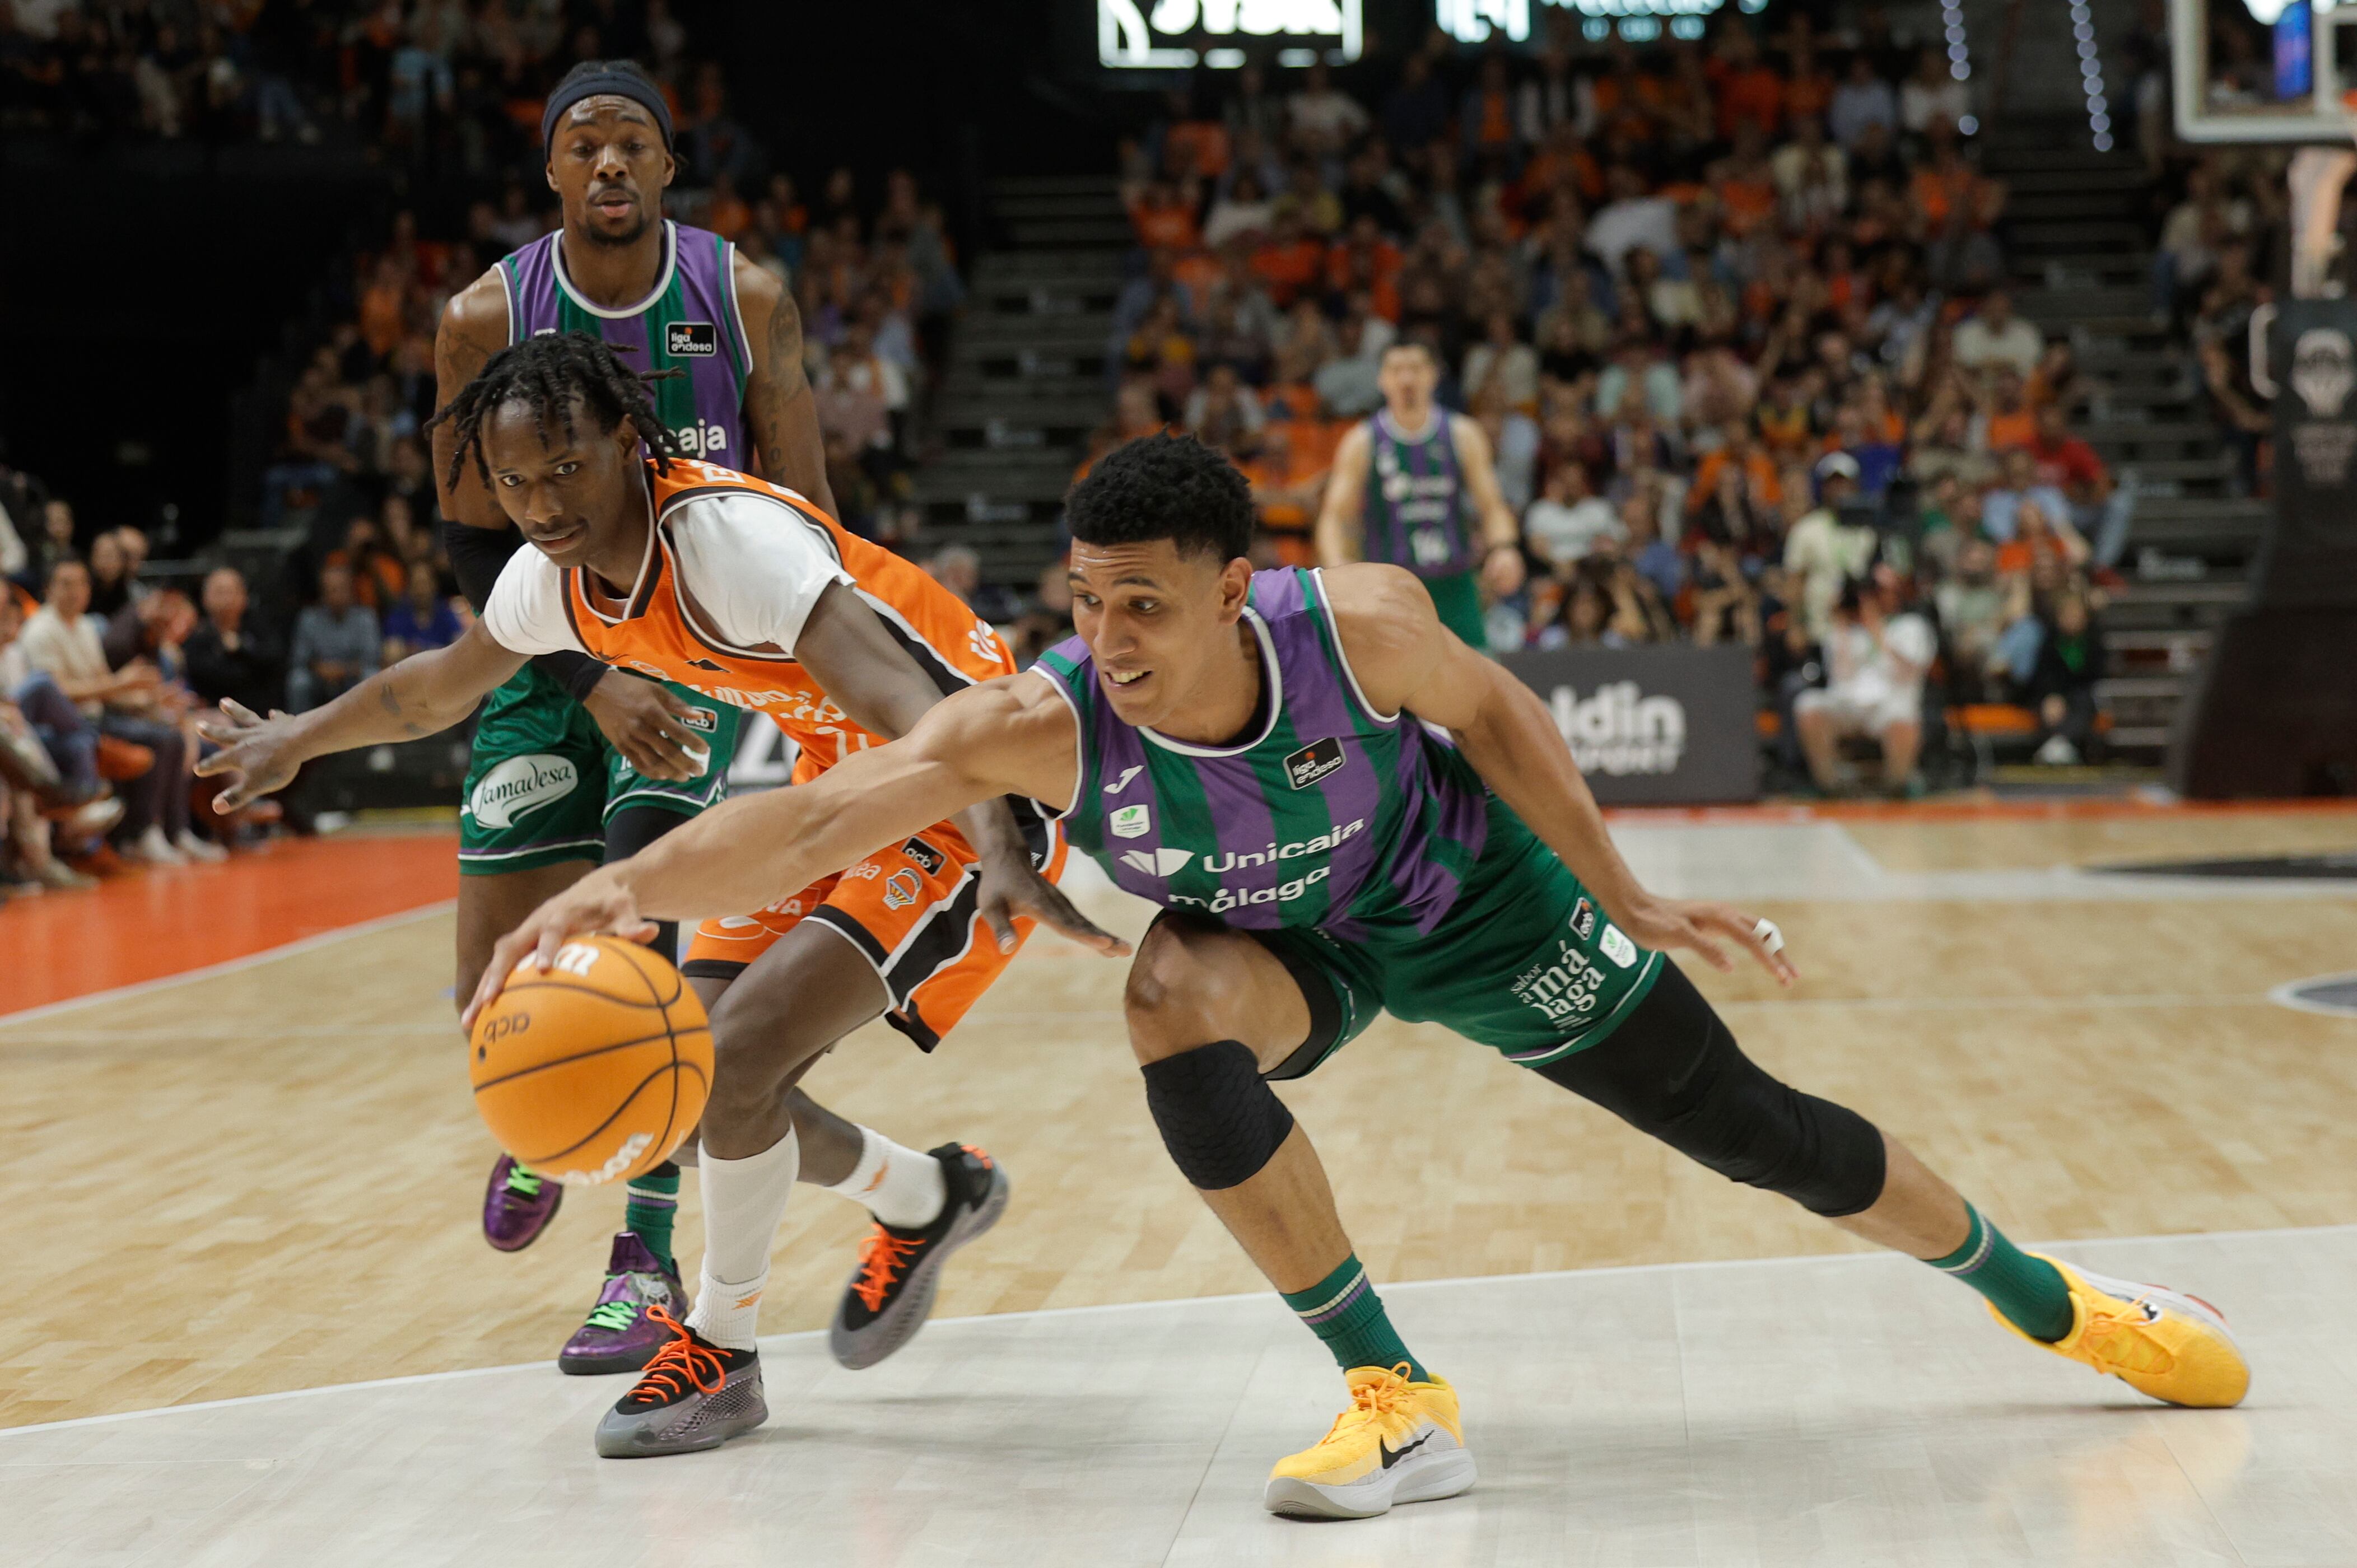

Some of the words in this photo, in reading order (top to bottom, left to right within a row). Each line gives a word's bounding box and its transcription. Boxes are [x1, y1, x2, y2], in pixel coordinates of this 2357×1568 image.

[671, 332, 690, 343] liga
[671, 342, 712, 352] endesa
[1550, 681, 1686, 748] ldin
[1292, 759, 1316, 776] liga
[1296, 756, 1342, 784] endesa
[476, 762, 571, 815] famadesa
[905, 847, 931, 868] acb
[1203, 818, 1364, 872] Unicaja
[1168, 866, 1331, 913] málaga
